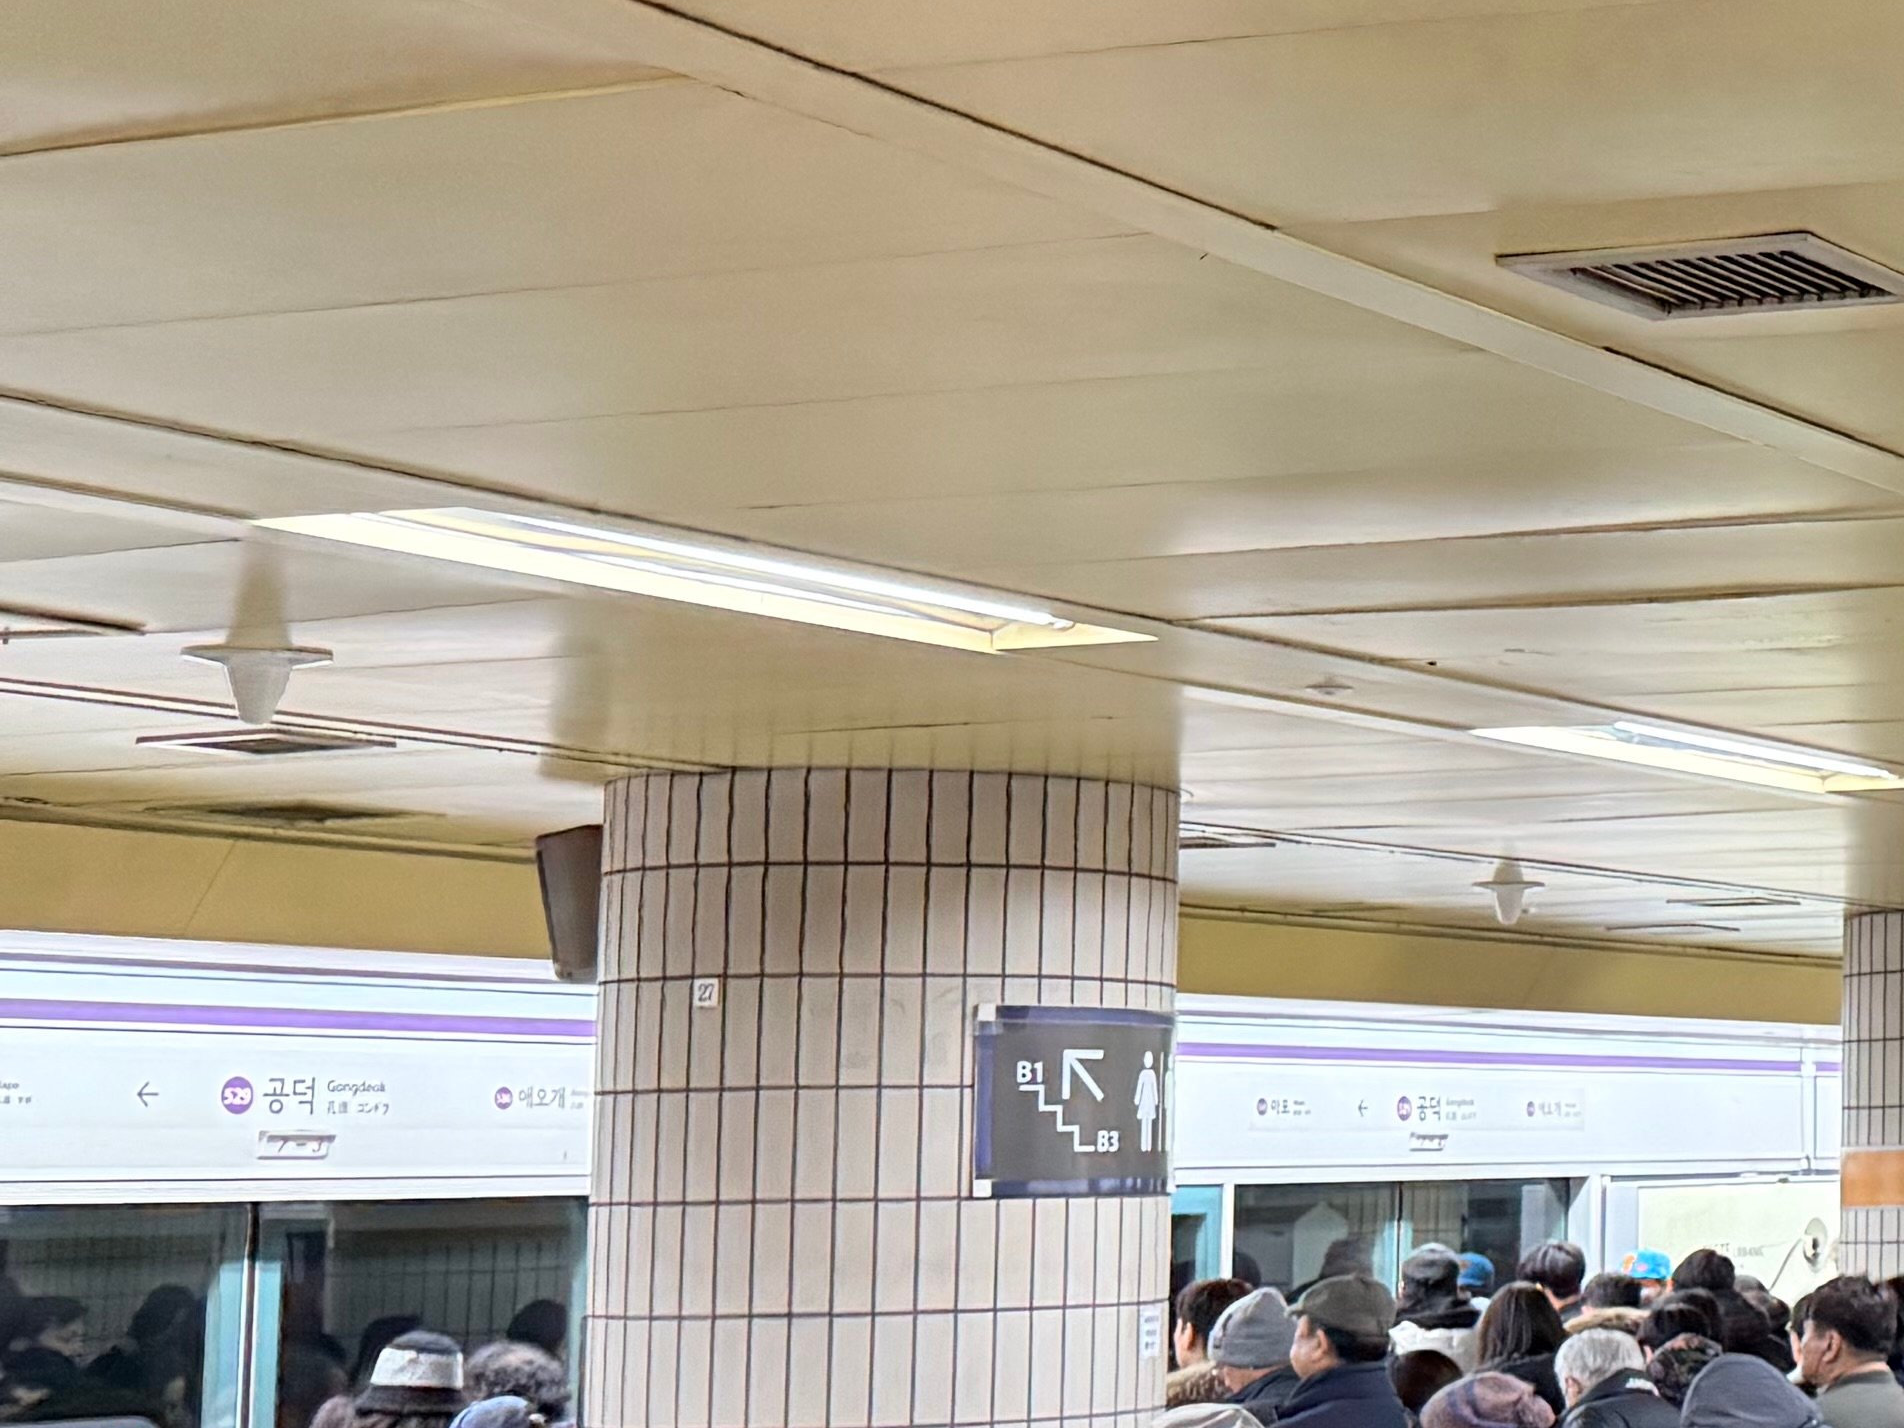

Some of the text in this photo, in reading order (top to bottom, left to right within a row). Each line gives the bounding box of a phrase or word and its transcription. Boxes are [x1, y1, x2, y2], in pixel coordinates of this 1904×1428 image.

[698, 983, 715, 1002] 27
[1016, 1060, 1043, 1084] B1
[223, 1086, 250, 1106] 529
[262, 1076, 316, 1116] 공덕
[518, 1085, 566, 1109] 애오개
[1417, 1095, 1442, 1122] 공덕
[1097, 1130, 1119, 1153] B3
